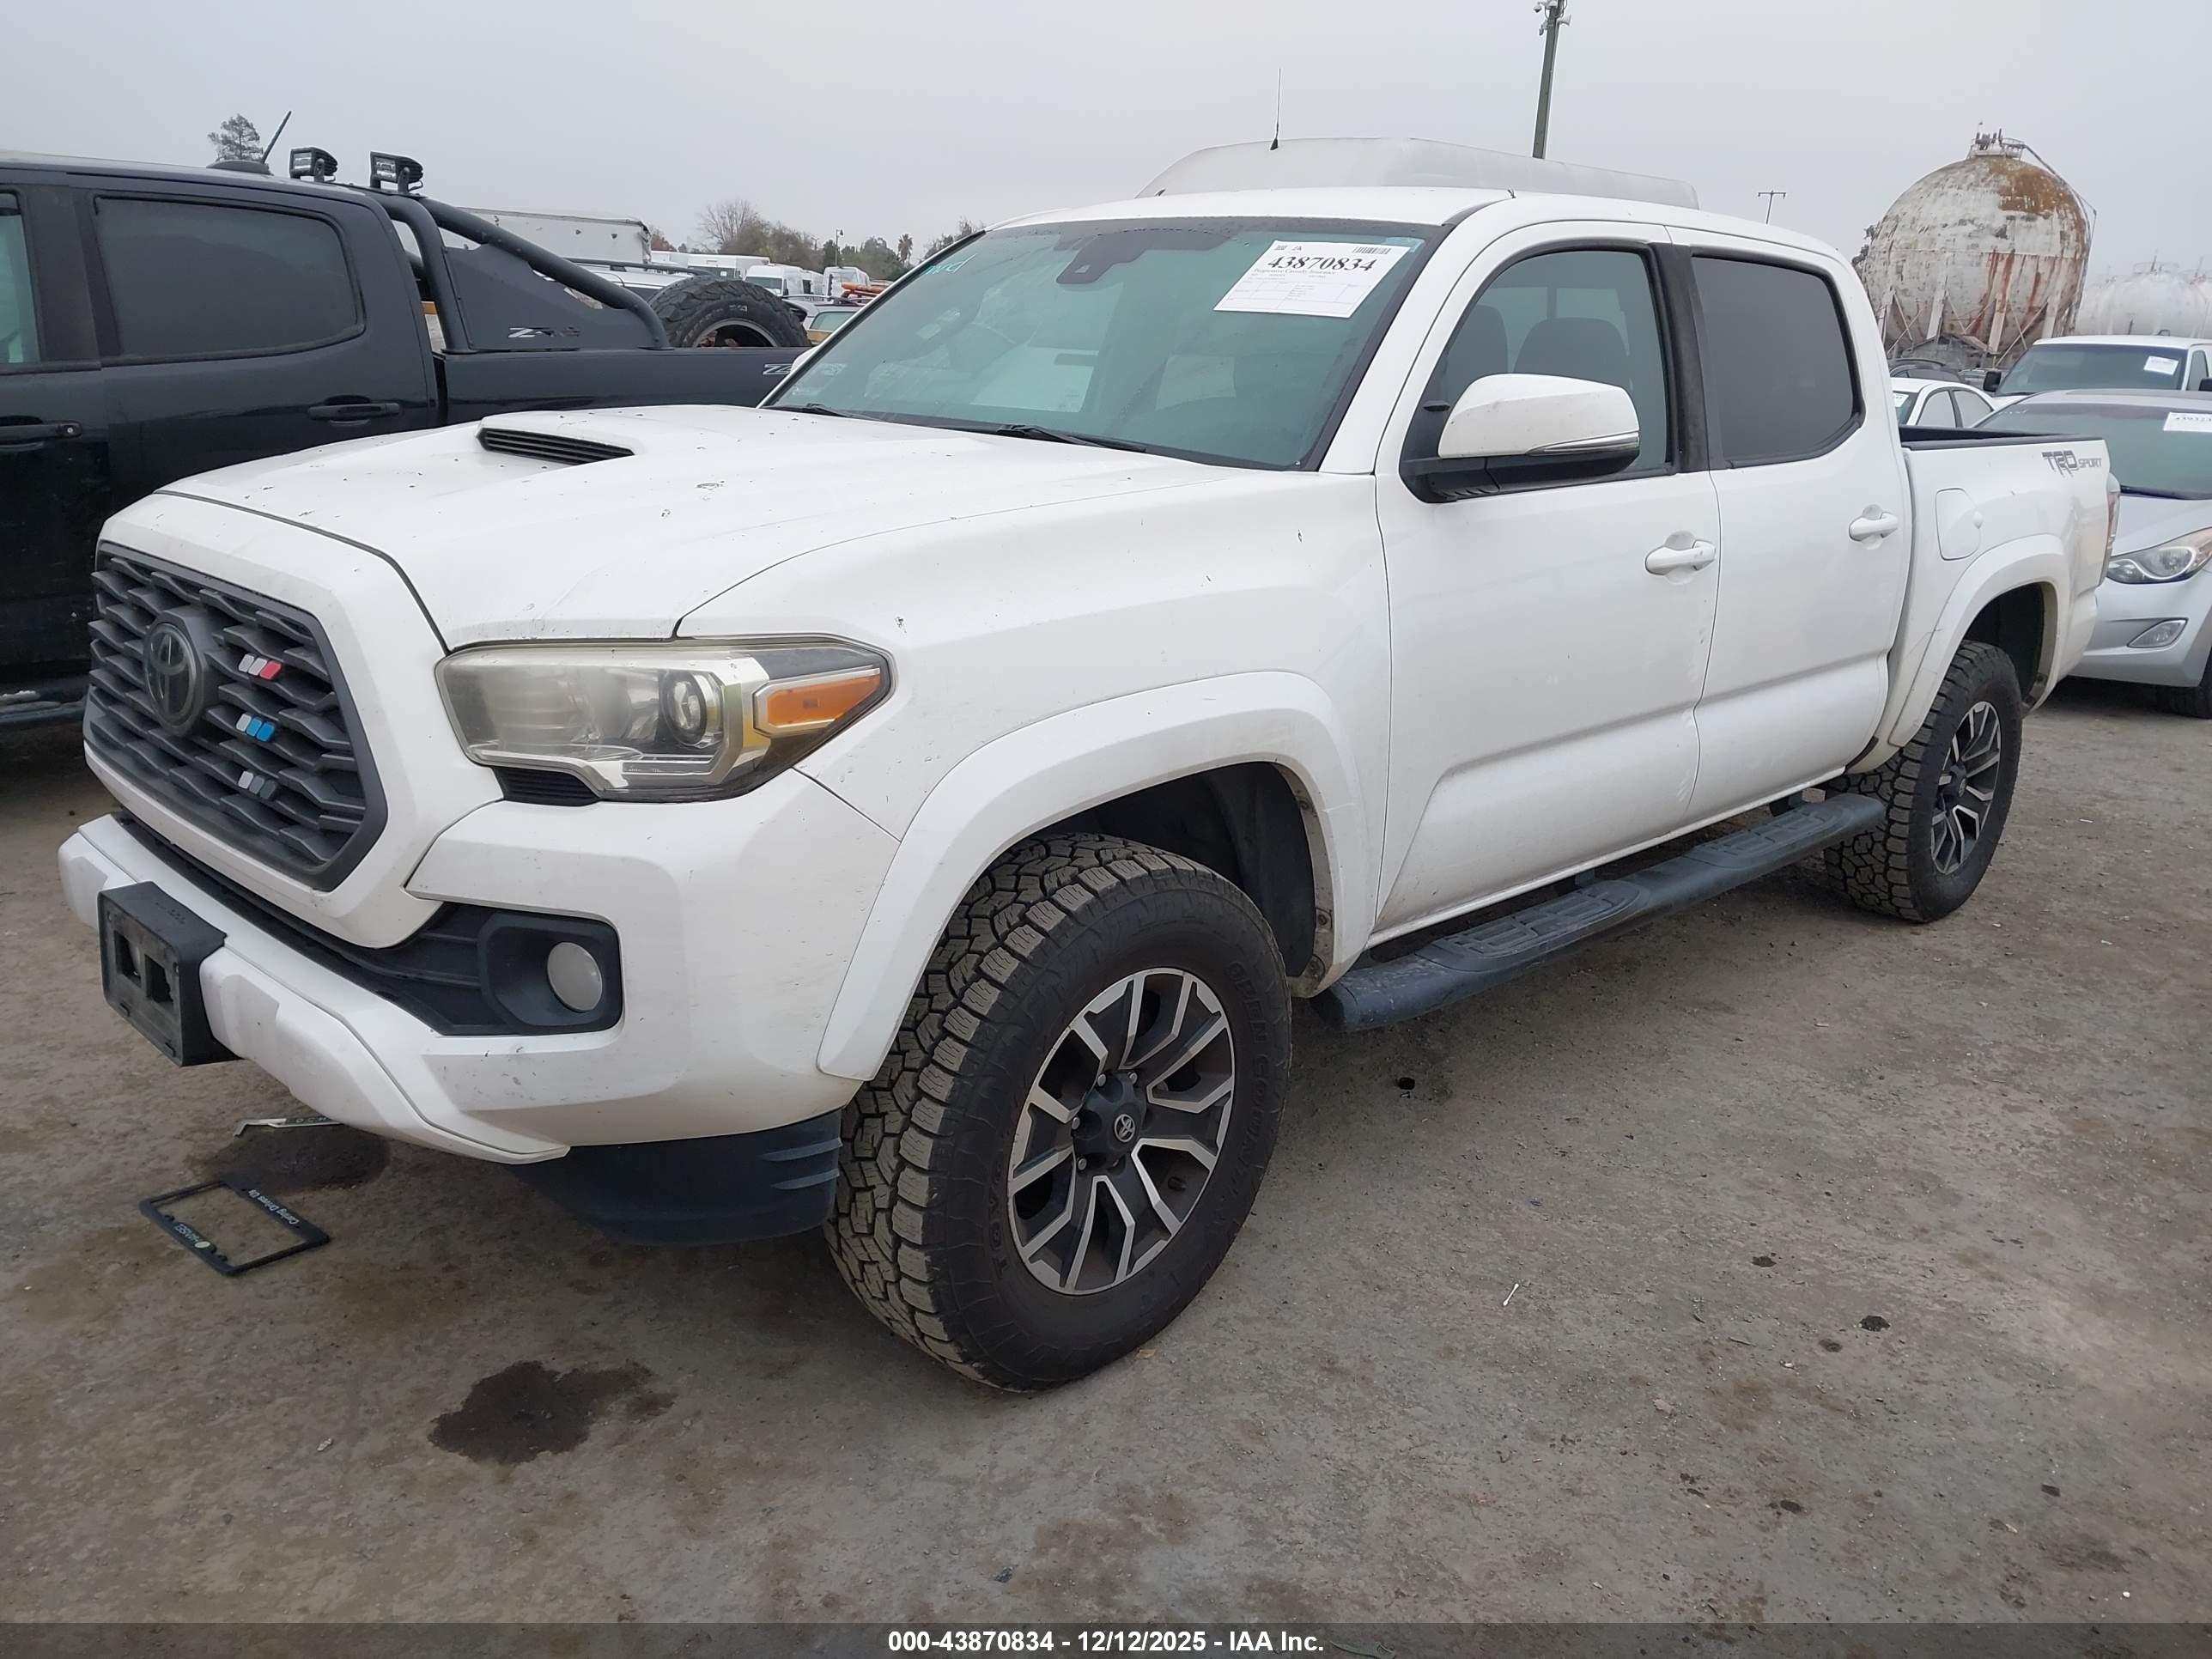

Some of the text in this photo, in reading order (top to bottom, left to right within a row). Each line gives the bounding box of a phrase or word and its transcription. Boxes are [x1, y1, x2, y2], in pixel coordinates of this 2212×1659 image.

[1268, 257, 1378, 271] 43870834
[2041, 451, 2102, 477] TRD SPORT
